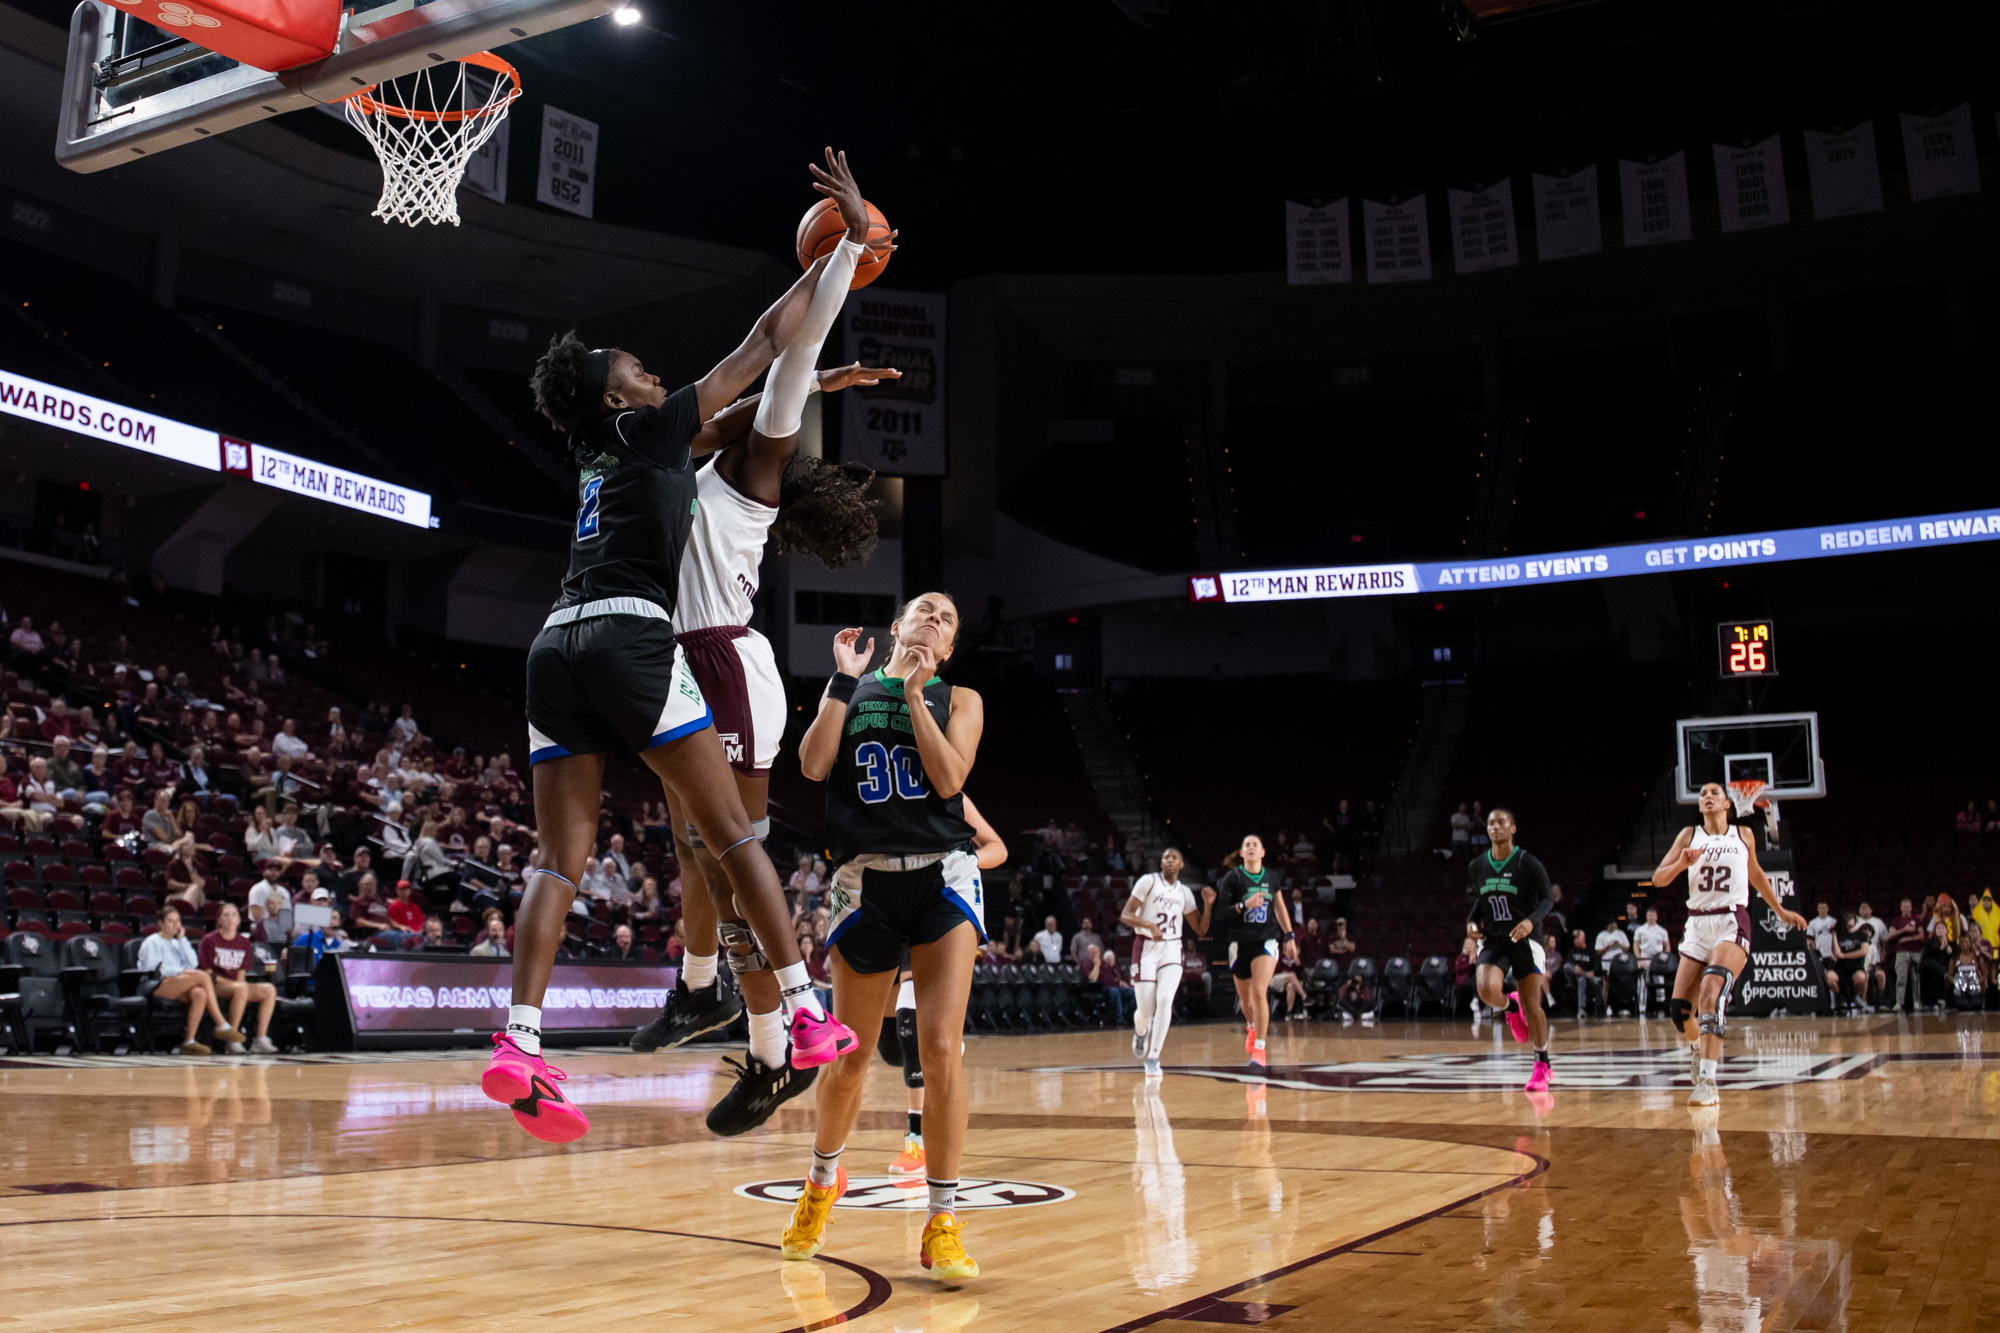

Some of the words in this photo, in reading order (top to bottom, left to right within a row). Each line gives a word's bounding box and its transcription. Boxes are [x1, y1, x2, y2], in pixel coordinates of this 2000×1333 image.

[553, 137, 585, 164] 2011
[1924, 145, 1956, 160] 2001
[1735, 161, 1764, 177] 1999
[551, 177, 581, 204] 852
[1737, 175, 1765, 190] 2001
[1737, 189, 1768, 204] 2003
[1643, 218, 1670, 233] 1997
[861, 301, 927, 322] NATIONAL
[852, 317, 936, 339] CHAMPIONS
[0, 381, 156, 445] WARDS.COM
[867, 407, 922, 435] 2011
[292, 464, 329, 494] MAN
[333, 475, 406, 515] REWARDS
[576, 474, 605, 542] 2
[1820, 524, 1914, 550] REDEEM
[1645, 547, 1688, 567] GET
[1693, 538, 1777, 562] POINTS
[1267, 575, 1308, 594] MAN
[1315, 570, 1405, 592] REWARDS
[1438, 564, 1520, 585] ATTEND
[1525, 555, 1609, 579] EVENTS
[1734, 624, 1769, 642] 7:19
[1730, 641, 1767, 672] 26
[858, 700, 899, 713] TEXAS
[846, 712, 889, 736] ORPUS
[855, 740, 930, 804] 30
[1698, 866, 1732, 892] 32
[1488, 895, 1513, 921] 11
[1156, 912, 1177, 934] 24
[1751, 951, 1806, 966] WELLS
[1753, 967, 1808, 982] FARGO
[350, 985, 435, 1009] TEXAS
[437, 986, 492, 1009] A&M
